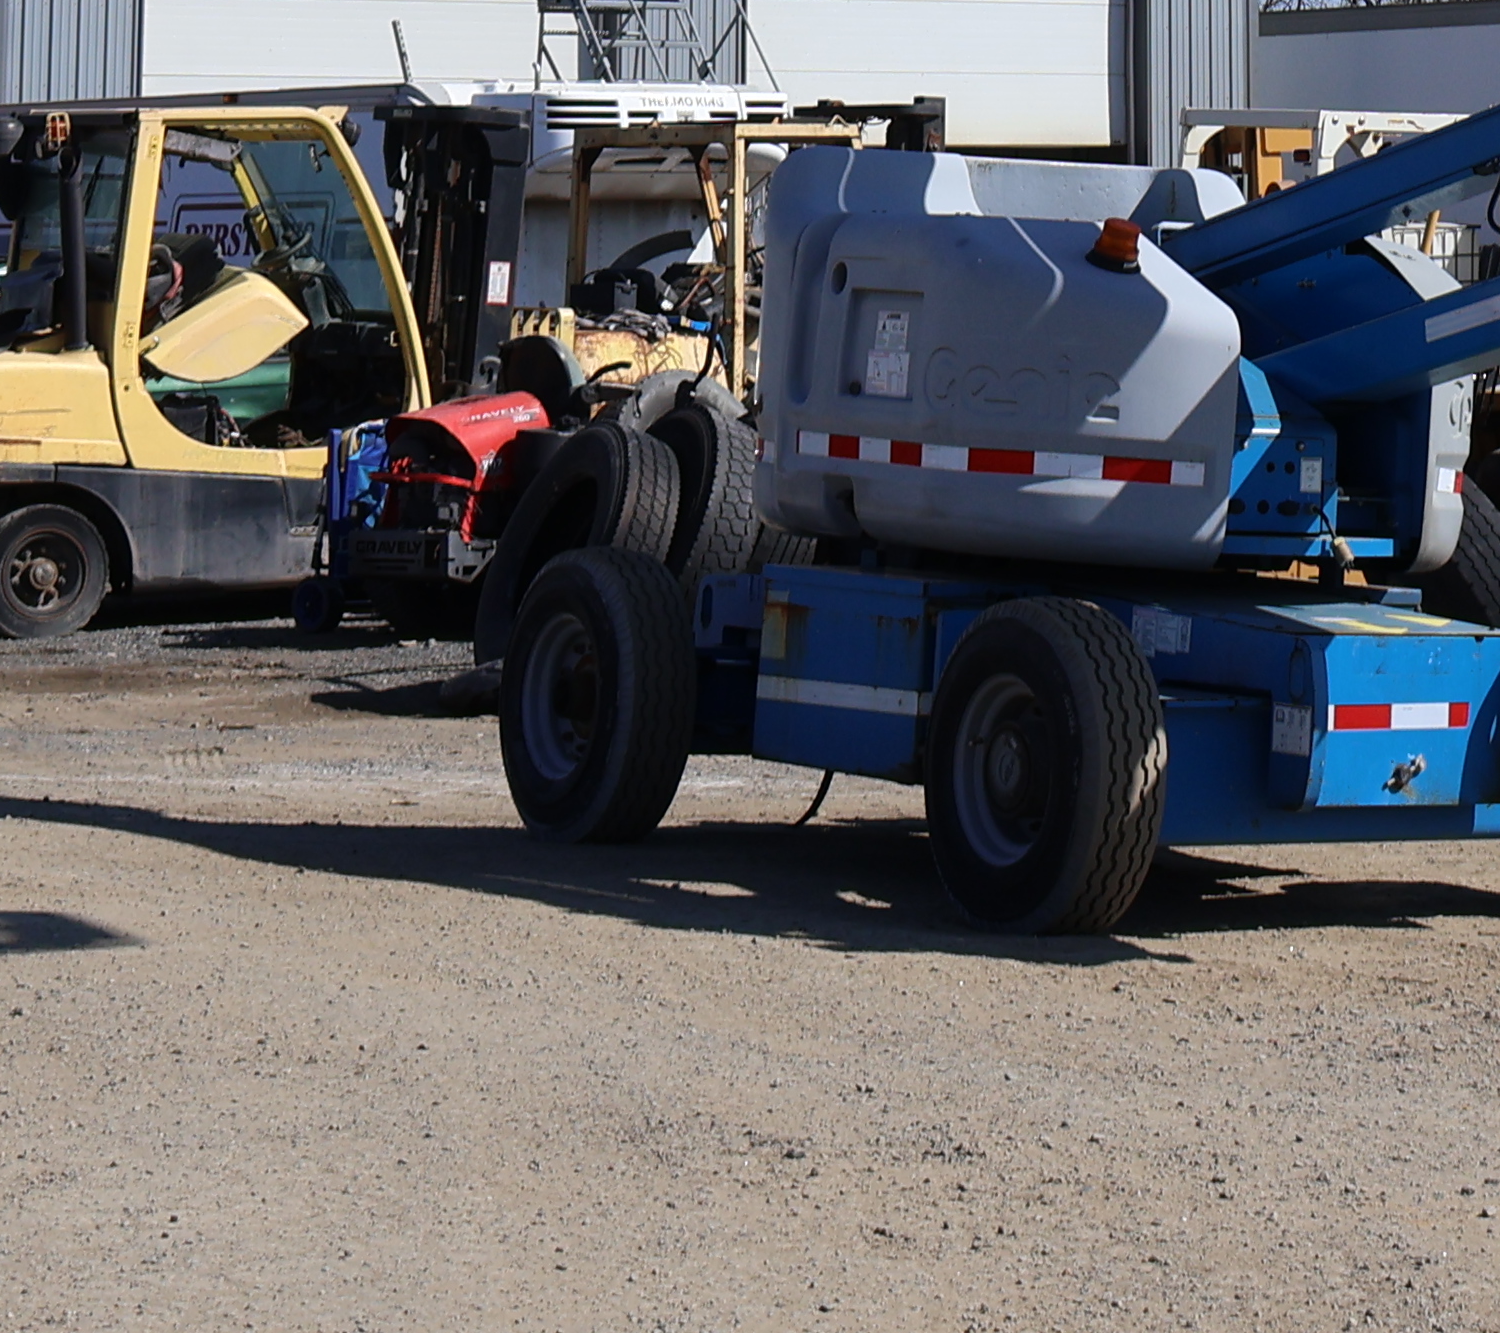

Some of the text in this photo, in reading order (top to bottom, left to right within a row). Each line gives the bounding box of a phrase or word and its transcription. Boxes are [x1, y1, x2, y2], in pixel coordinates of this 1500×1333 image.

[640, 97, 724, 108] THERMO KING
[925, 346, 1120, 422] Genie
[356, 540, 422, 554] GRAVELY
